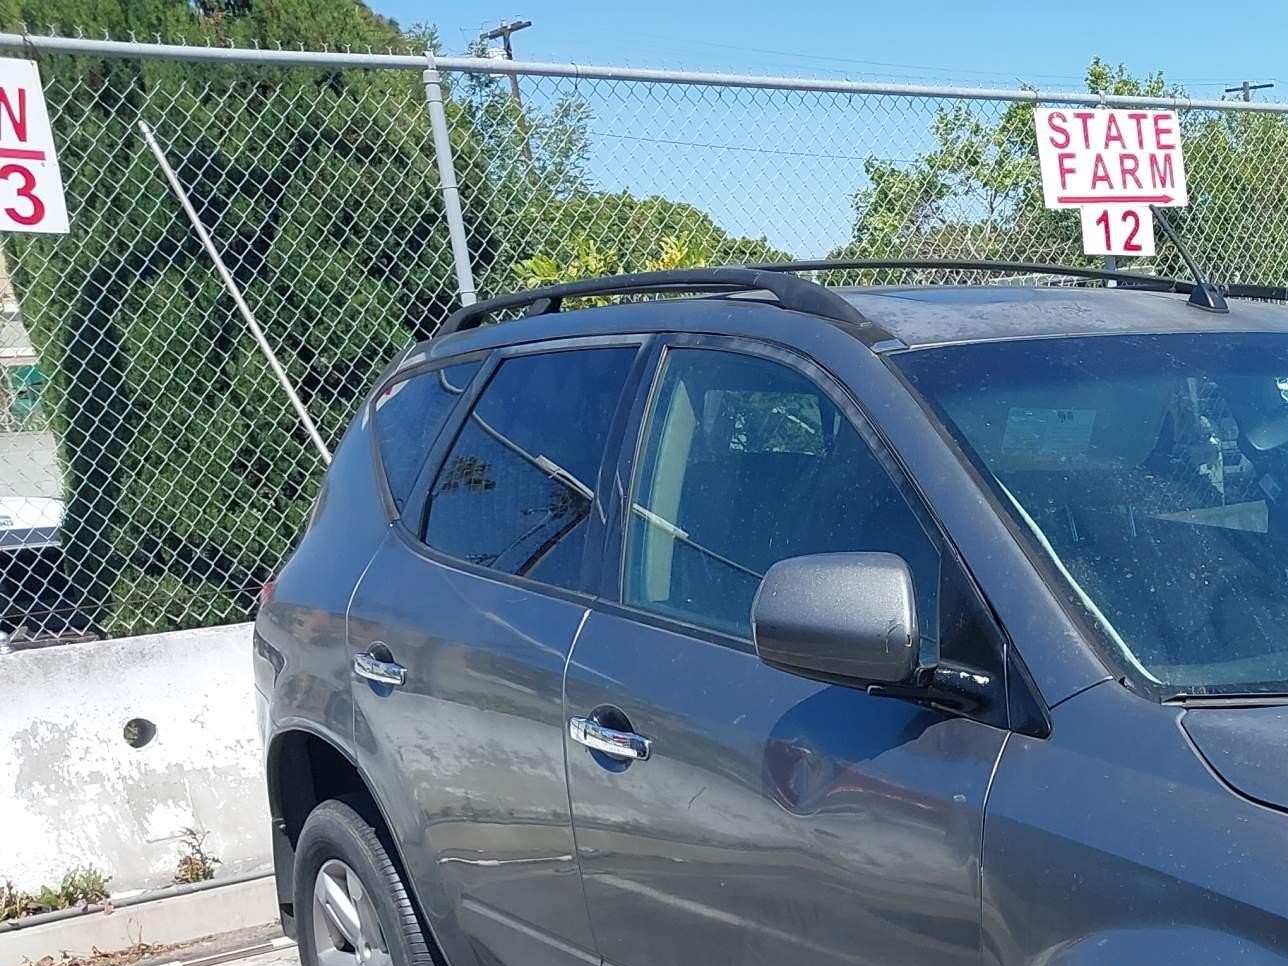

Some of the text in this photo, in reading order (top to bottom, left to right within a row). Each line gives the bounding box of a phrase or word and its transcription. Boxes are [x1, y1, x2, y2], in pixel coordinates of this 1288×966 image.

[0, 87, 27, 142] N
[1047, 111, 1176, 150] STATE
[1057, 152, 1175, 190] FARM
[0, 163, 45, 226] 3
[1095, 209, 1143, 252] 12
